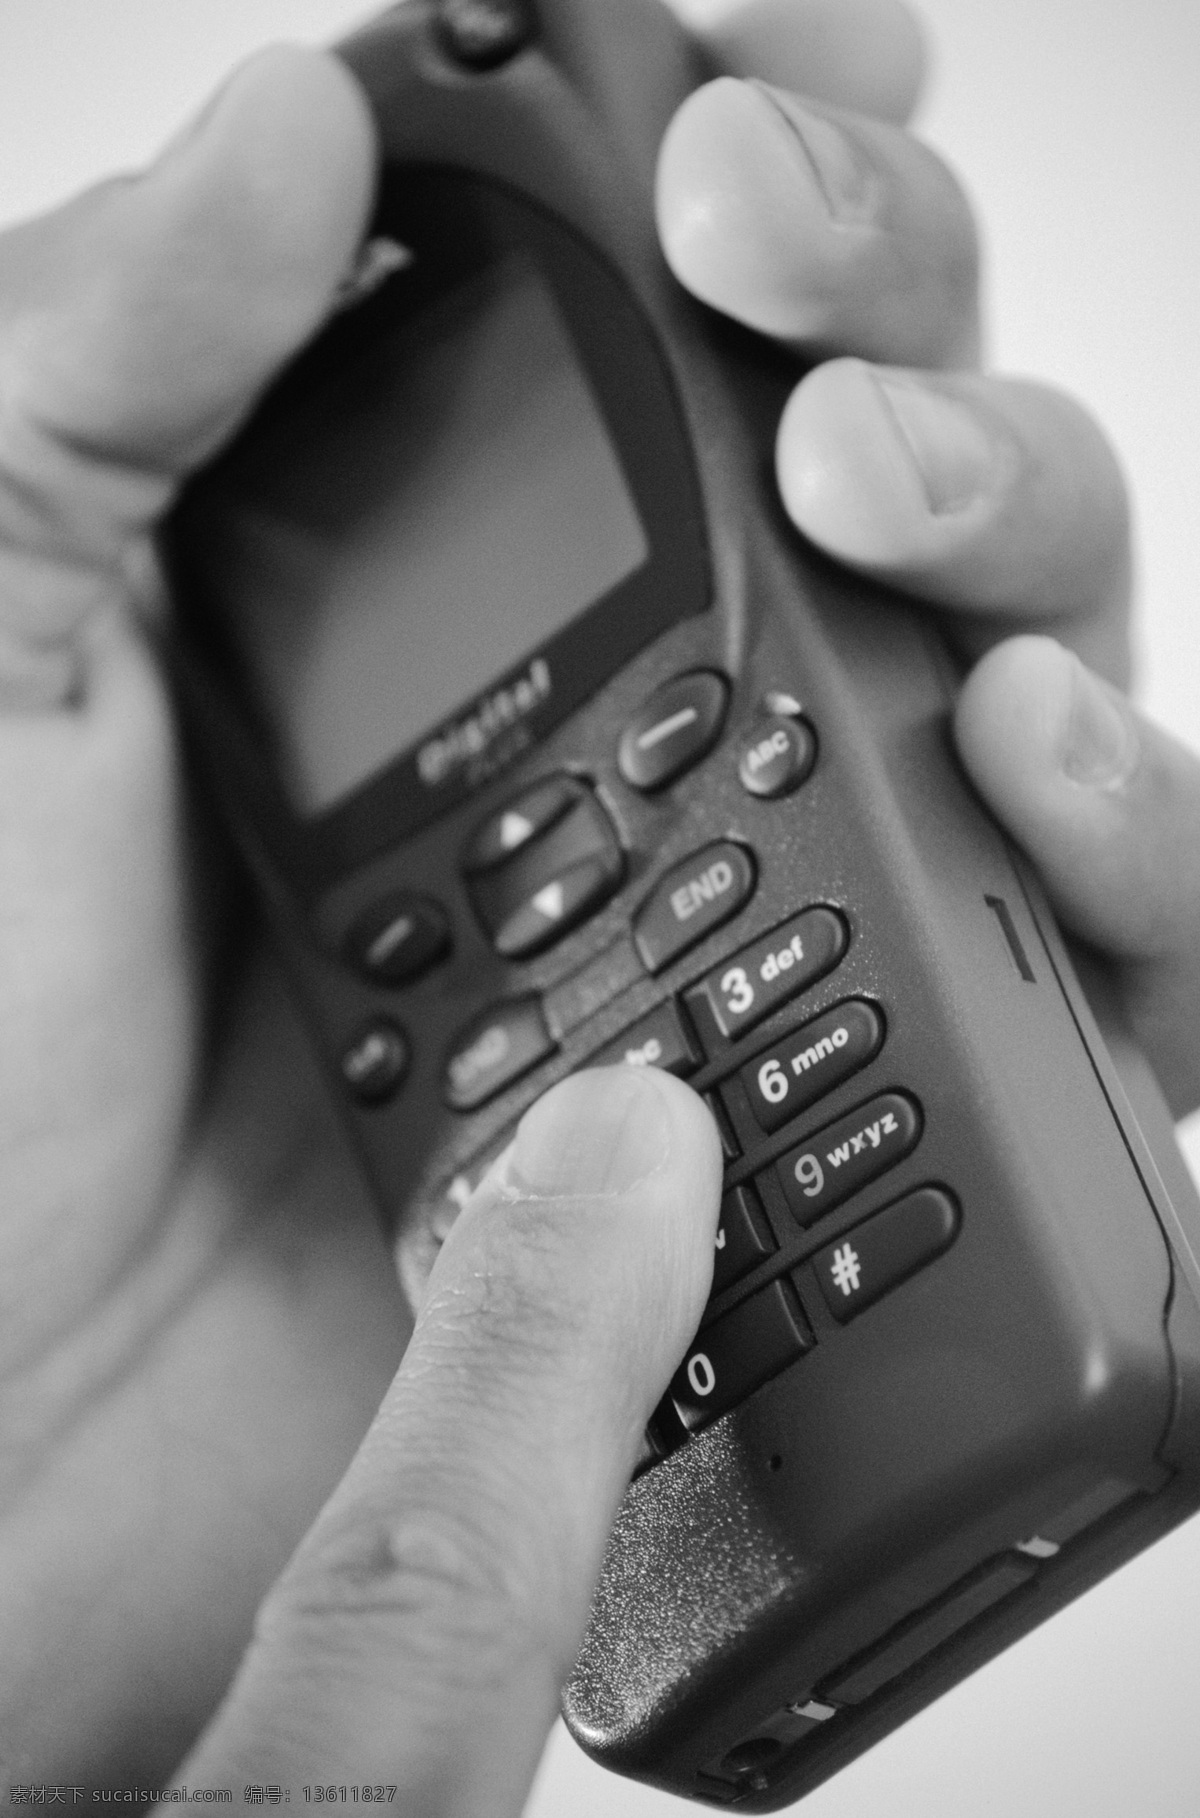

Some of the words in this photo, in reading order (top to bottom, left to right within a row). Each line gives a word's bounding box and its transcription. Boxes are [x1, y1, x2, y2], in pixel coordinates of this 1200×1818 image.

[746, 731, 790, 771] ABC
[669, 861, 732, 920] END
[721, 967, 754, 1013] 3
[760, 935, 804, 981] def
[758, 1059, 789, 1103] 6
[790, 1027, 849, 1076] mno
[794, 1154, 824, 1197] 9
[827, 1112, 898, 1168] wxyz
[687, 1353, 716, 1396] 0
